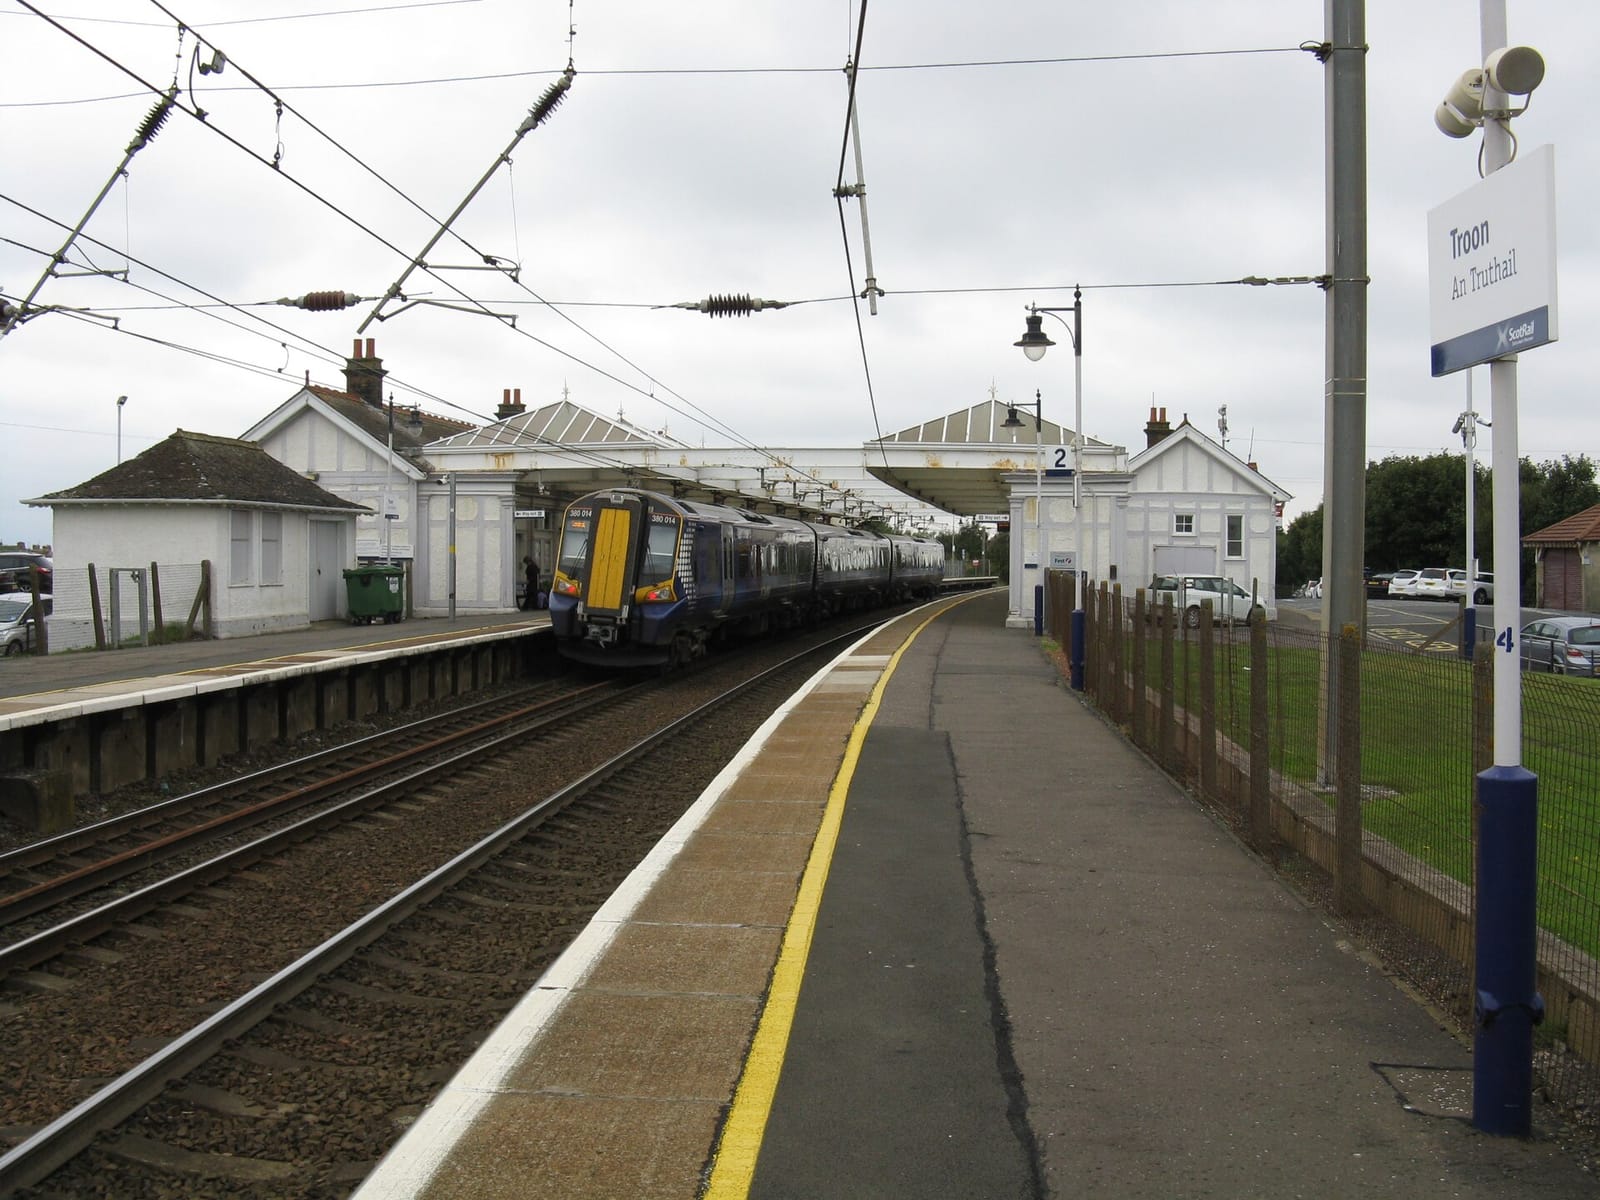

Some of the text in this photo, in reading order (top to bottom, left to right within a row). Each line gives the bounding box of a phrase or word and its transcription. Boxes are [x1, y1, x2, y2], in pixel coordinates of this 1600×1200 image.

[1450, 220, 1489, 260] Troon
[1451, 248, 1517, 300] An Truthail
[1508, 319, 1535, 342] ScotRail
[1054, 448, 1066, 468] 2
[651, 514, 676, 524] 380 014
[1496, 626, 1514, 653] 4
